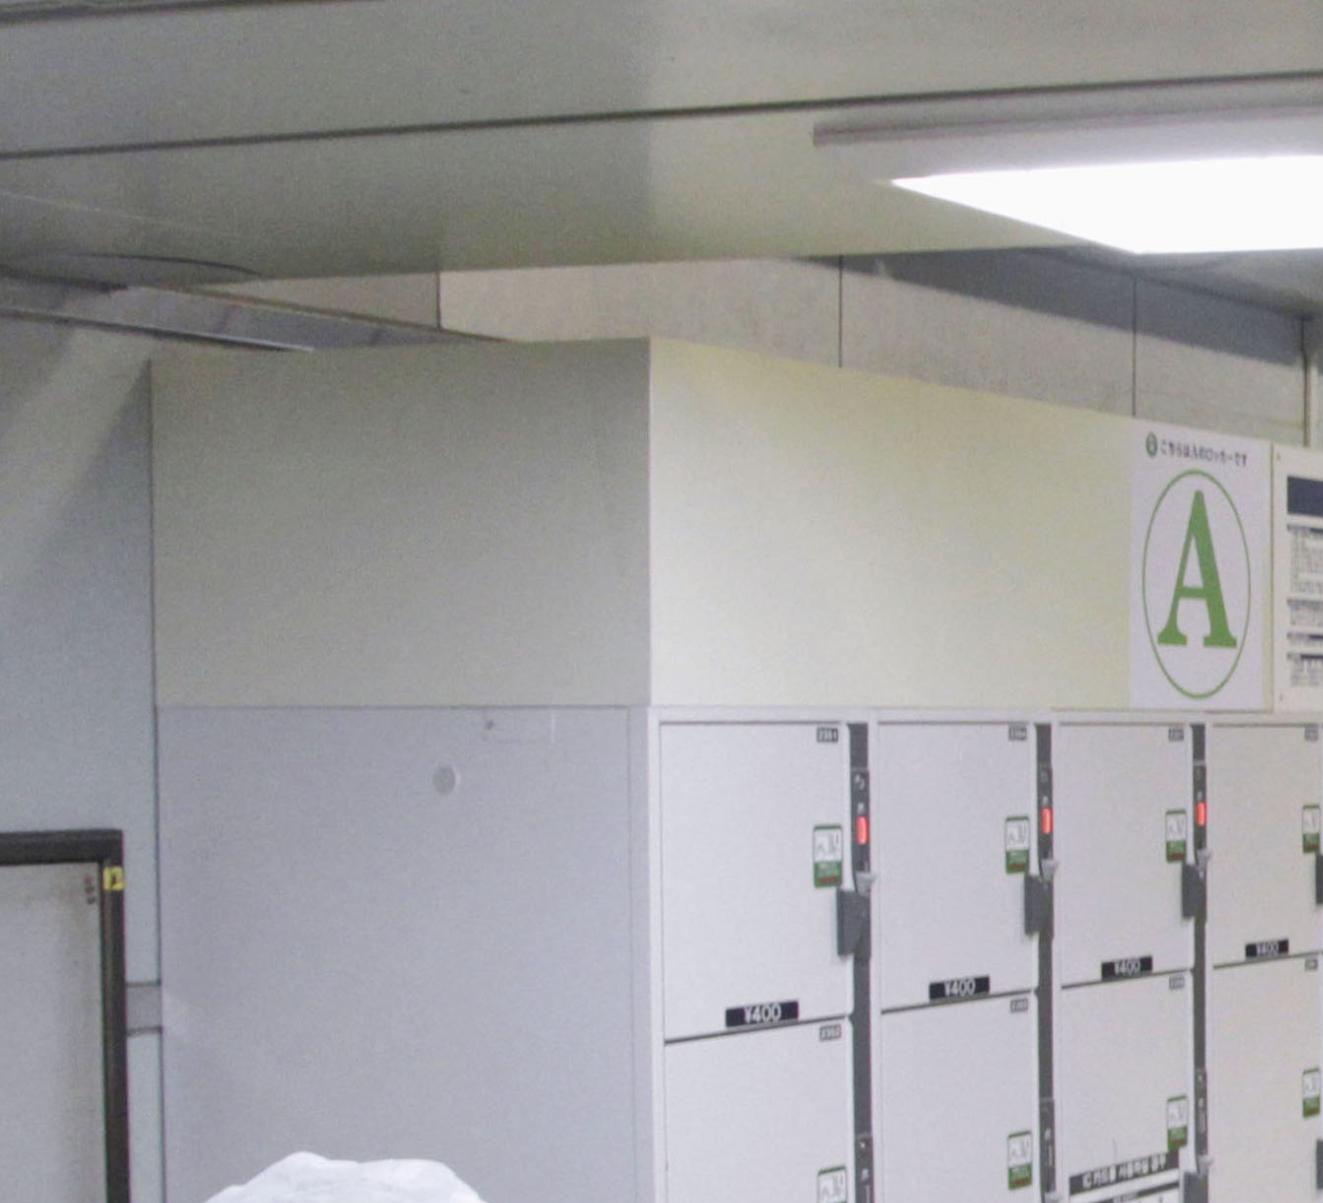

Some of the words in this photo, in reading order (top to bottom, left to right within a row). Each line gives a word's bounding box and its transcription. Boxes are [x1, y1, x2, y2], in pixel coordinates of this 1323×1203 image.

[1156, 490, 1238, 648] A
[943, 977, 976, 996] ¥400
[743, 1004, 782, 1023] ¥400
